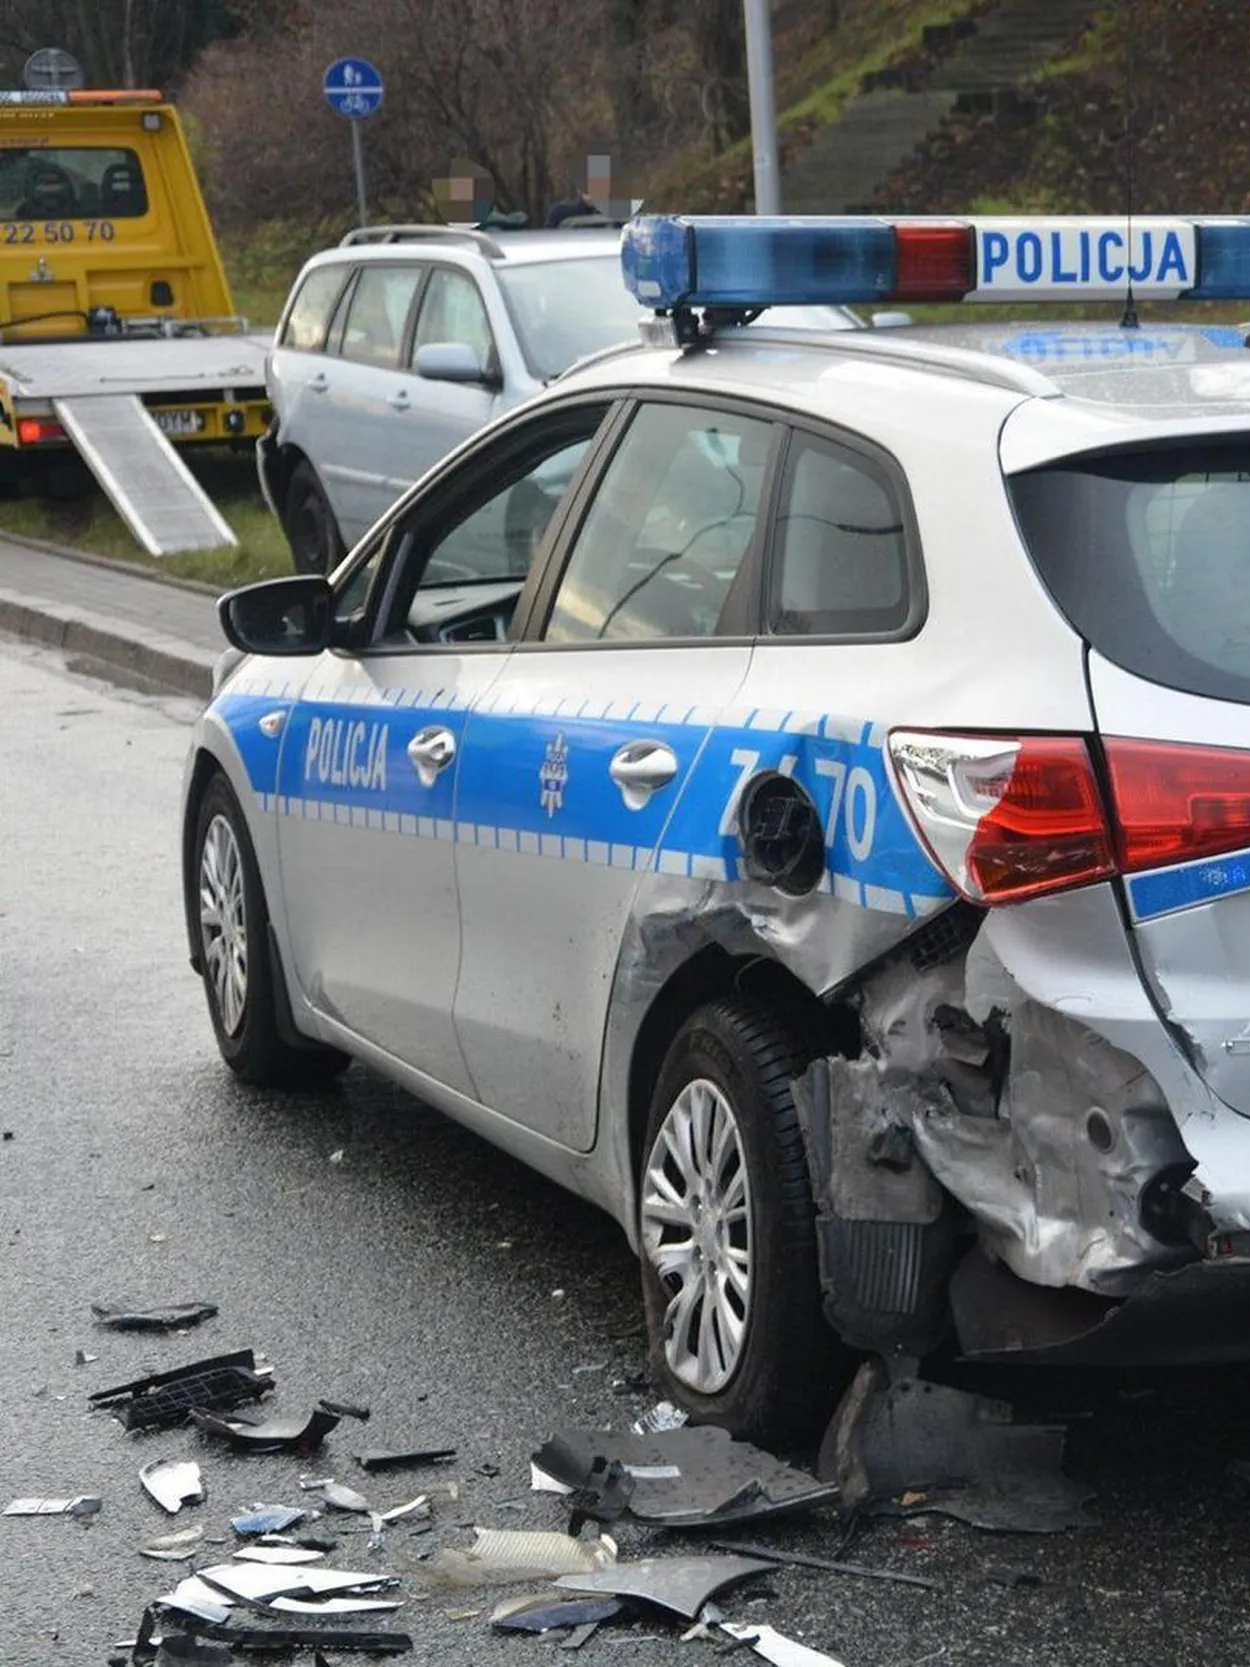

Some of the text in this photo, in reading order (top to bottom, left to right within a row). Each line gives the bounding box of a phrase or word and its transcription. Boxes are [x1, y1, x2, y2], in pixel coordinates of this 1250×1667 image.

[4, 220, 115, 244] 22 50 70
[982, 231, 1187, 283] POLICJA
[305, 717, 389, 792] POLICJA
[718, 748, 877, 862] Z70
